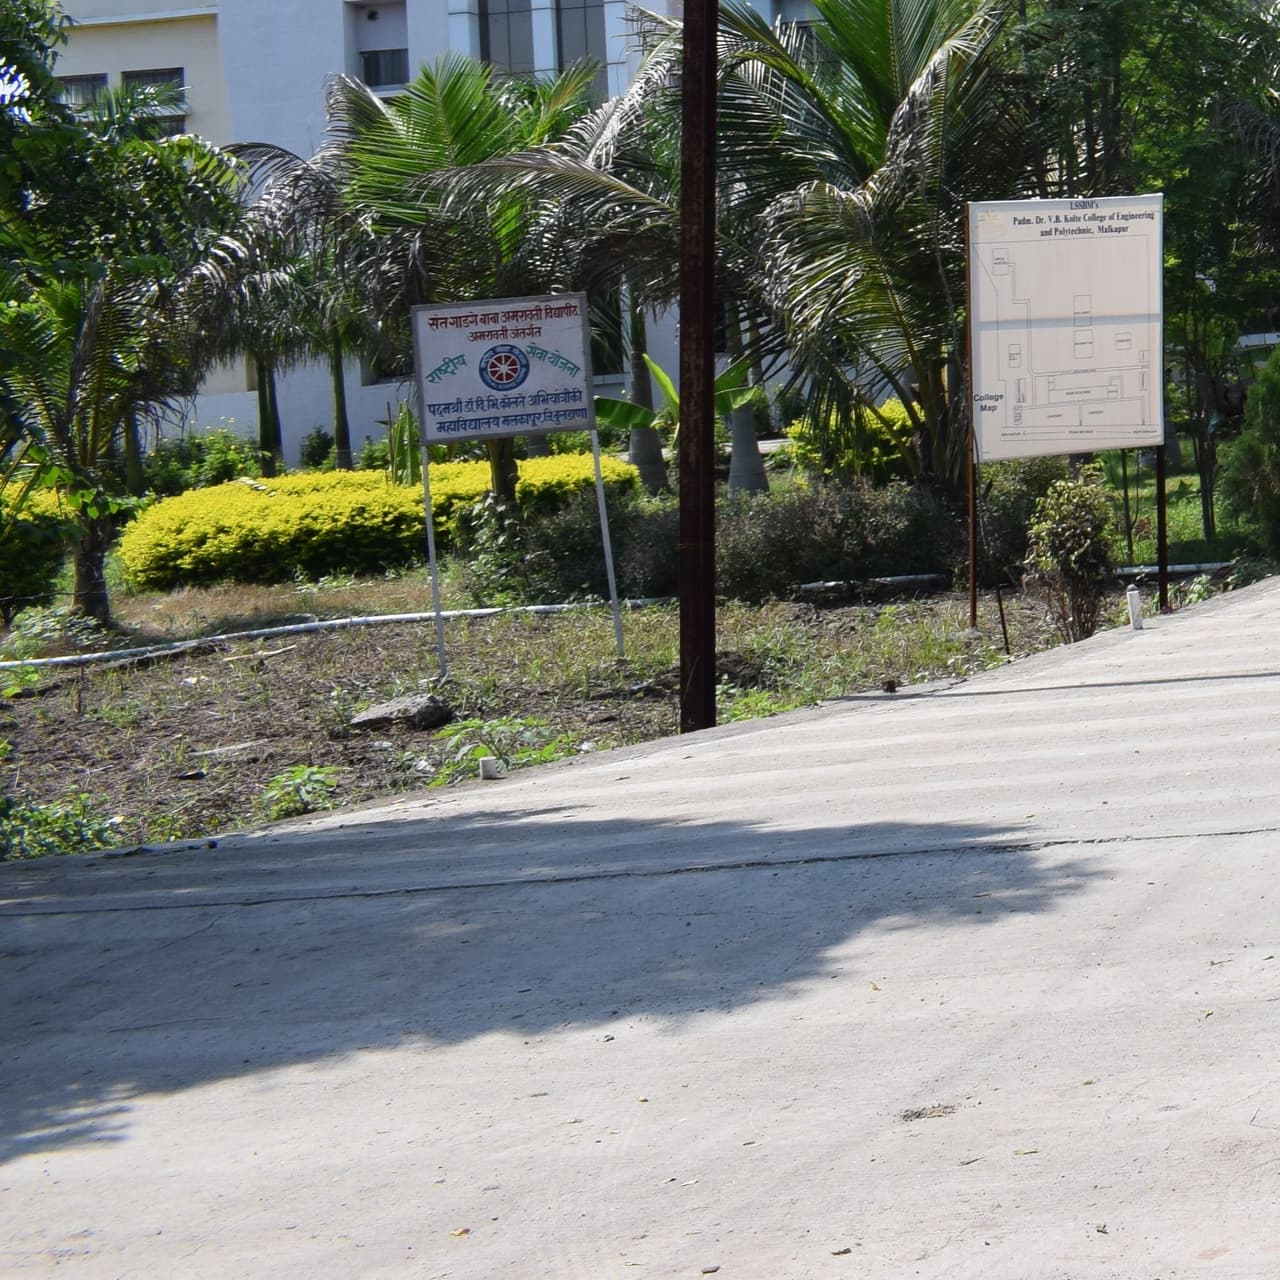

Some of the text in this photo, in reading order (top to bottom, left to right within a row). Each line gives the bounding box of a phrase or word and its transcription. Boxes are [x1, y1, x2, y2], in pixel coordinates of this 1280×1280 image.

[1083, 212, 1106, 223] College
[974, 393, 1004, 413] College Map
